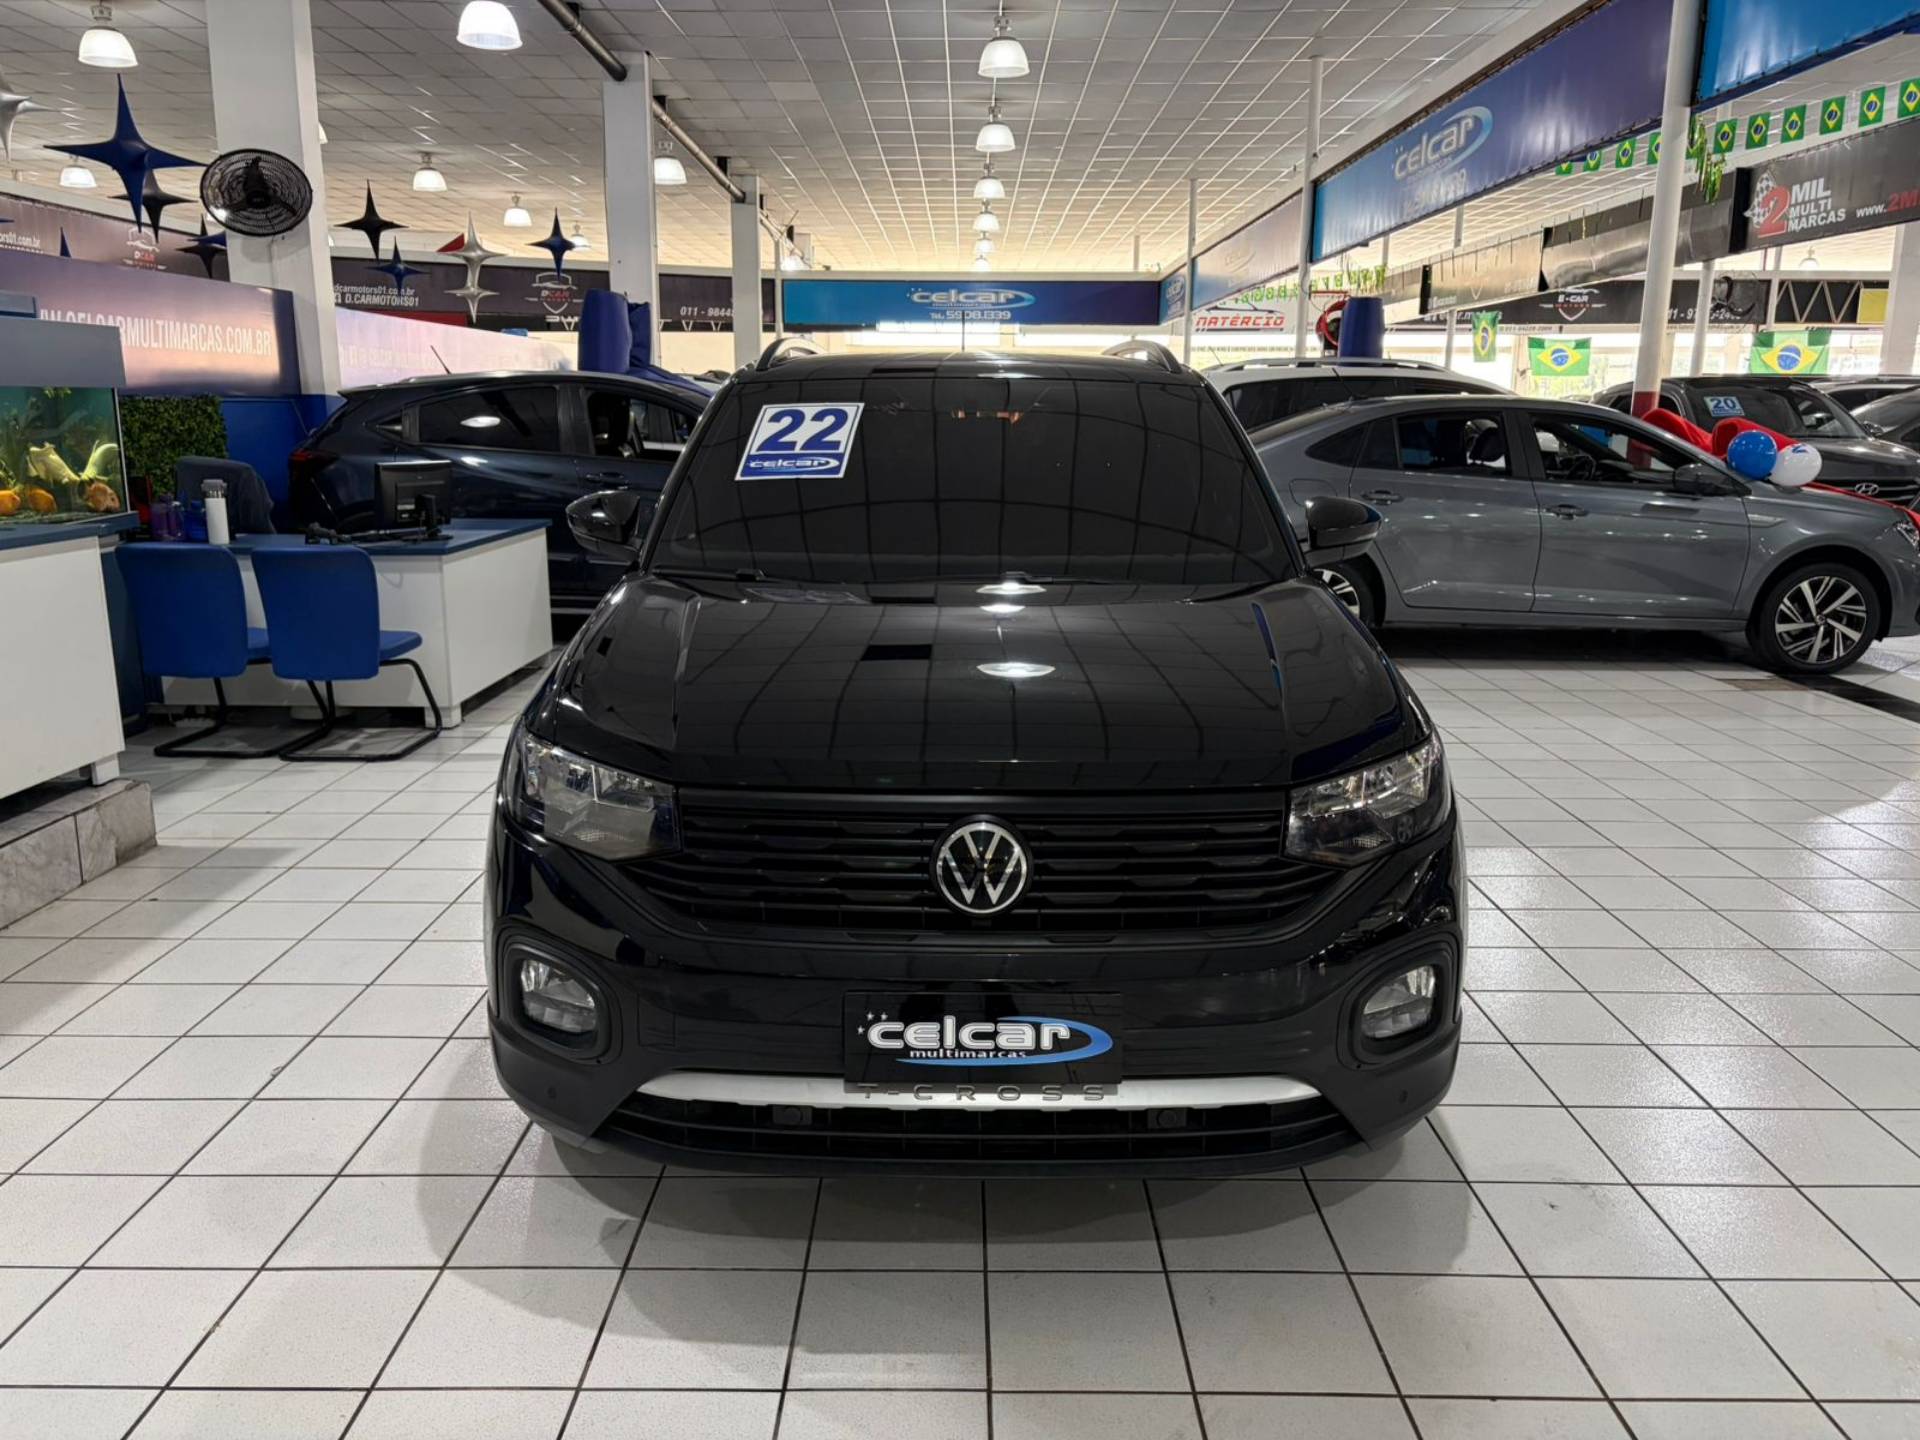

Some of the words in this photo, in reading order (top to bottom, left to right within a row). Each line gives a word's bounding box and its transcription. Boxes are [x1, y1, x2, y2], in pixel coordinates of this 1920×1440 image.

[1395, 117, 1475, 181] celcar
[1791, 177, 1832, 204] MIL
[1789, 197, 1833, 220] MULTI
[1856, 188, 1920, 219] www.2M
[1787, 207, 1847, 233] MARCAS
[911, 289, 1016, 304] celcar
[679, 306, 698, 317] 011
[1711, 397, 1737, 410] 20
[755, 407, 848, 452] 22
[749, 458, 827, 469] celcar
[867, 1014, 1071, 1051] celcar
[909, 1048, 1027, 1060] multimarcas
[857, 1083, 1105, 1101] T-CROSS
